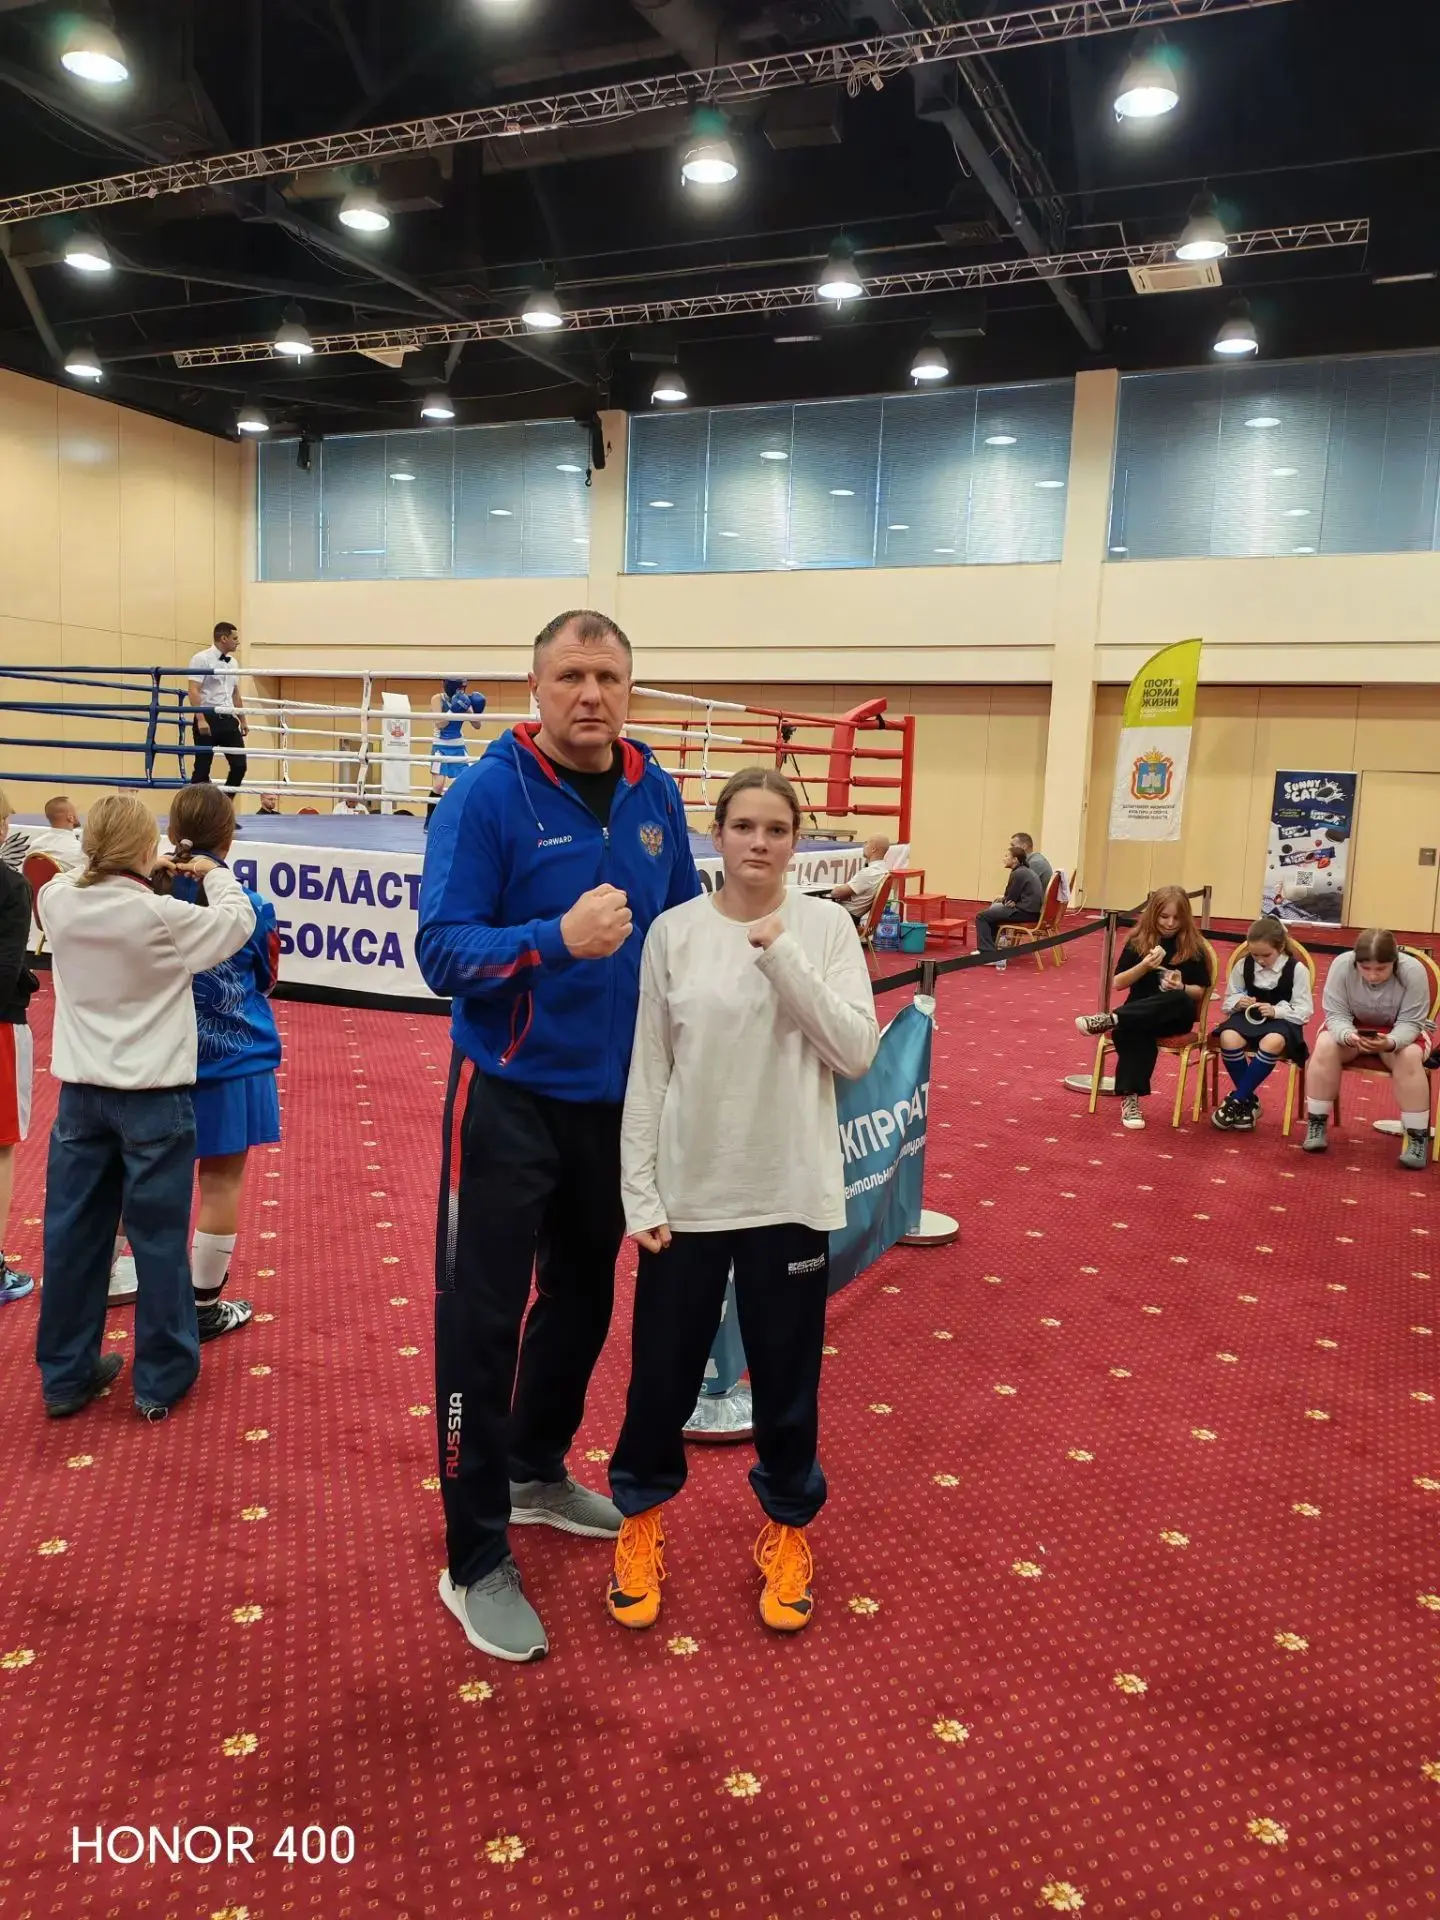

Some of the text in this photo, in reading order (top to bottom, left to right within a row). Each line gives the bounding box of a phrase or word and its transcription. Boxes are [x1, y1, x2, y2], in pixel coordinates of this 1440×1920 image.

[1144, 678, 1174, 688] СПОРТ
[1142, 688, 1180, 697] НОРМА
[1141, 698, 1179, 708] ЖИЗНИ
[1284, 780, 1321, 793] FUNNY
[1291, 788, 1319, 803] CAT
[537, 835, 573, 848] FORWARD
[269, 861, 422, 911] ОБЛАСТ
[276, 919, 405, 969] БОКСА
[446, 1392, 463, 1478] RUSSIA
